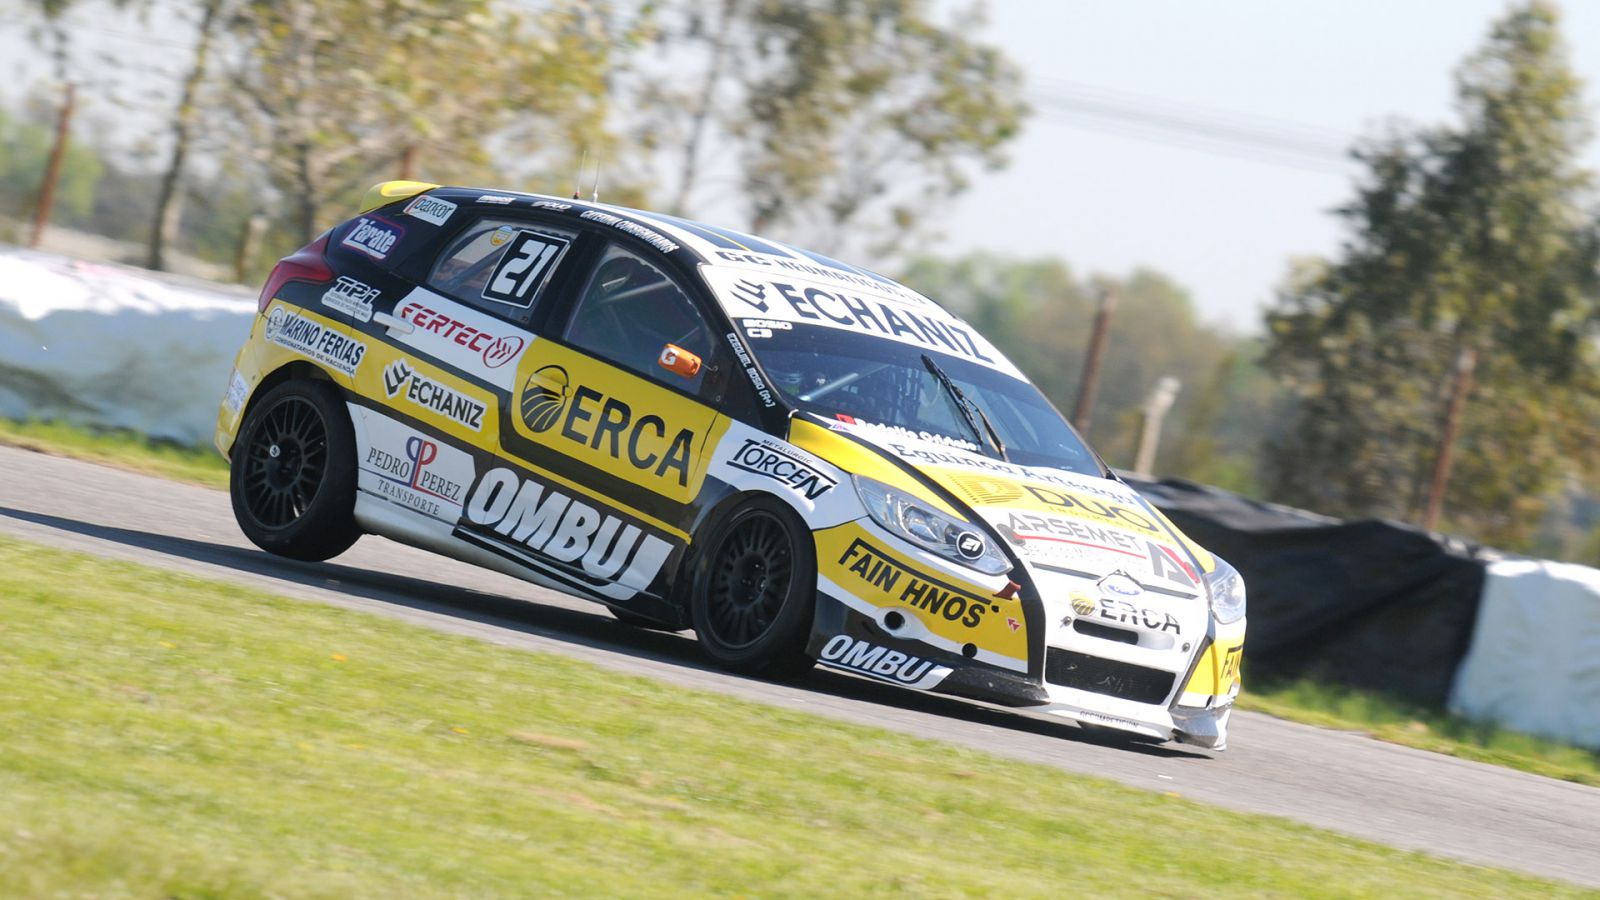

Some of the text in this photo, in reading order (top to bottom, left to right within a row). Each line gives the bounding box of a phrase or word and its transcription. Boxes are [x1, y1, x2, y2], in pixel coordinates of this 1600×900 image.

[491, 239, 559, 298] 21
[281, 313, 364, 366] MARINO FERIAS
[401, 302, 493, 353] FERTEC
[771, 281, 996, 365] ECHANIZ
[408, 375, 484, 429] ECHANIZ
[561, 384, 694, 488] ERCA
[366, 446, 461, 502] PEDRO PEREZ
[733, 438, 833, 501] TORCEN
[377, 479, 440, 516] TRANSPORTE
[1022, 485, 1160, 532] DUO
[468, 467, 648, 582] OMBU
[960, 536, 981, 552] 21
[1008, 513, 1143, 552] ARSEMET
[838, 537, 986, 628] FAIN HNOS
[1099, 597, 1181, 635] ERCA
[820, 634, 933, 682] OMBU
